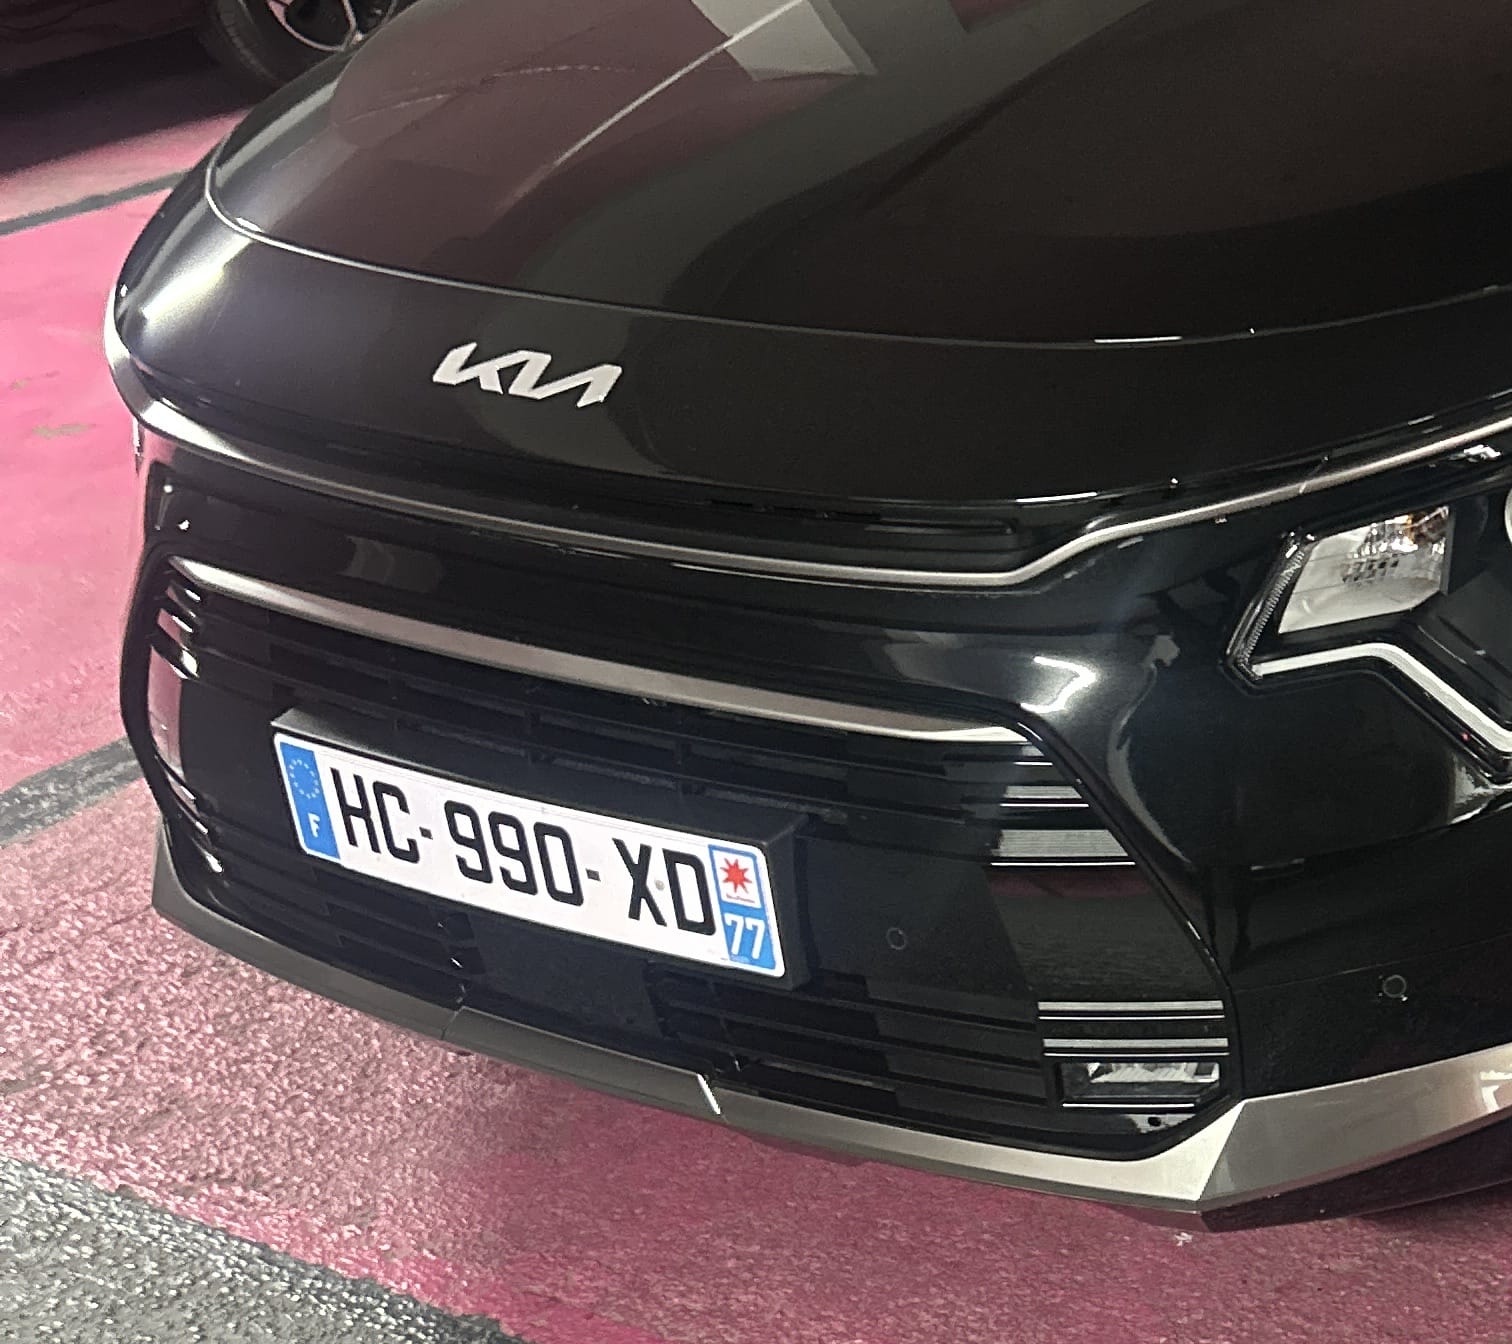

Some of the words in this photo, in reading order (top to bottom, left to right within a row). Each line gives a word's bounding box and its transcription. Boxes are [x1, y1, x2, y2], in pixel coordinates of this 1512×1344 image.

[432, 342, 622, 408] KIA
[308, 812, 321, 838] F
[330, 767, 717, 936] HC-990-XD
[724, 912, 766, 960] 77
